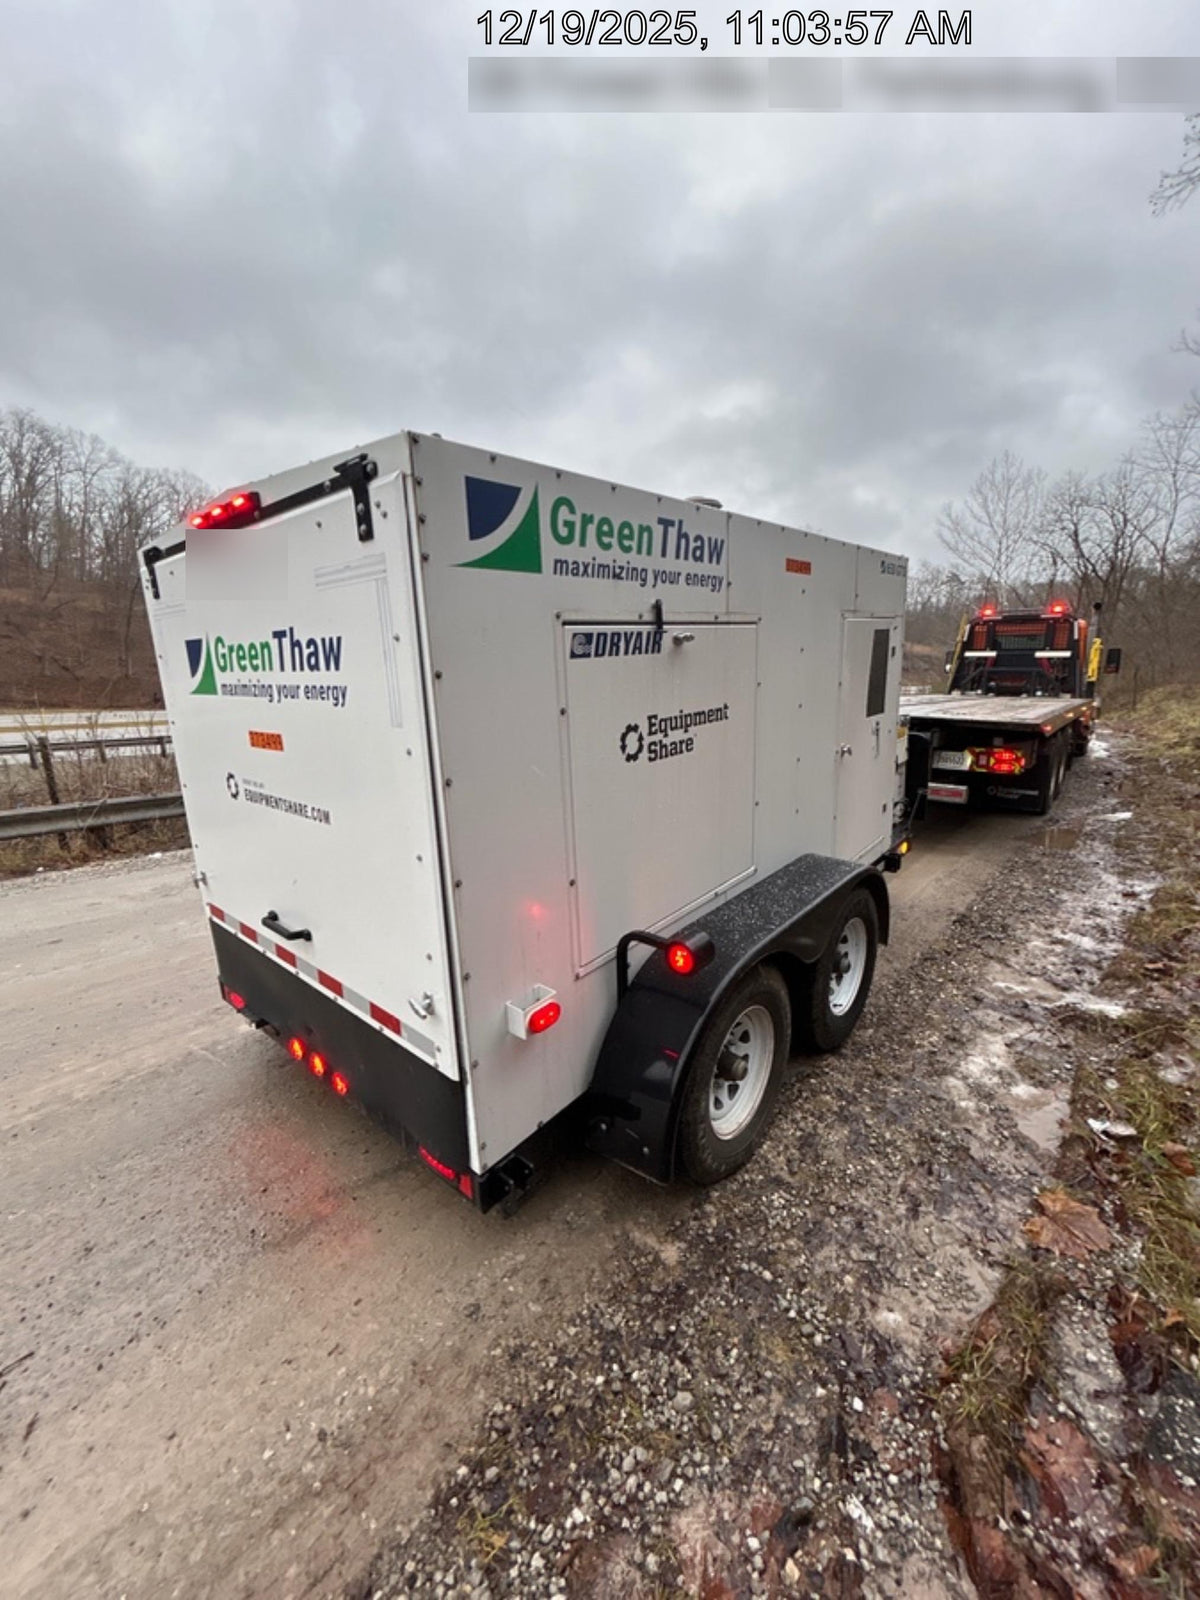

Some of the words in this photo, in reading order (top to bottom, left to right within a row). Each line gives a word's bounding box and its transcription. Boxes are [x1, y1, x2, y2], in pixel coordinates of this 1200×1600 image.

[550, 496, 725, 566] GreenThaw
[553, 557, 648, 588] maximizing
[652, 569, 682, 589] your
[685, 571, 724, 593] energy
[214, 626, 342, 673] GreenThaw
[593, 630, 664, 658] DRYAIR
[221, 679, 274, 704] maximizing
[276, 683, 301, 704] your
[303, 683, 348, 708] energy
[647, 703, 729, 738] Equipment
[647, 737, 694, 763] Share
[244, 788, 332, 826] EQUIPMENTSHARE.COM
